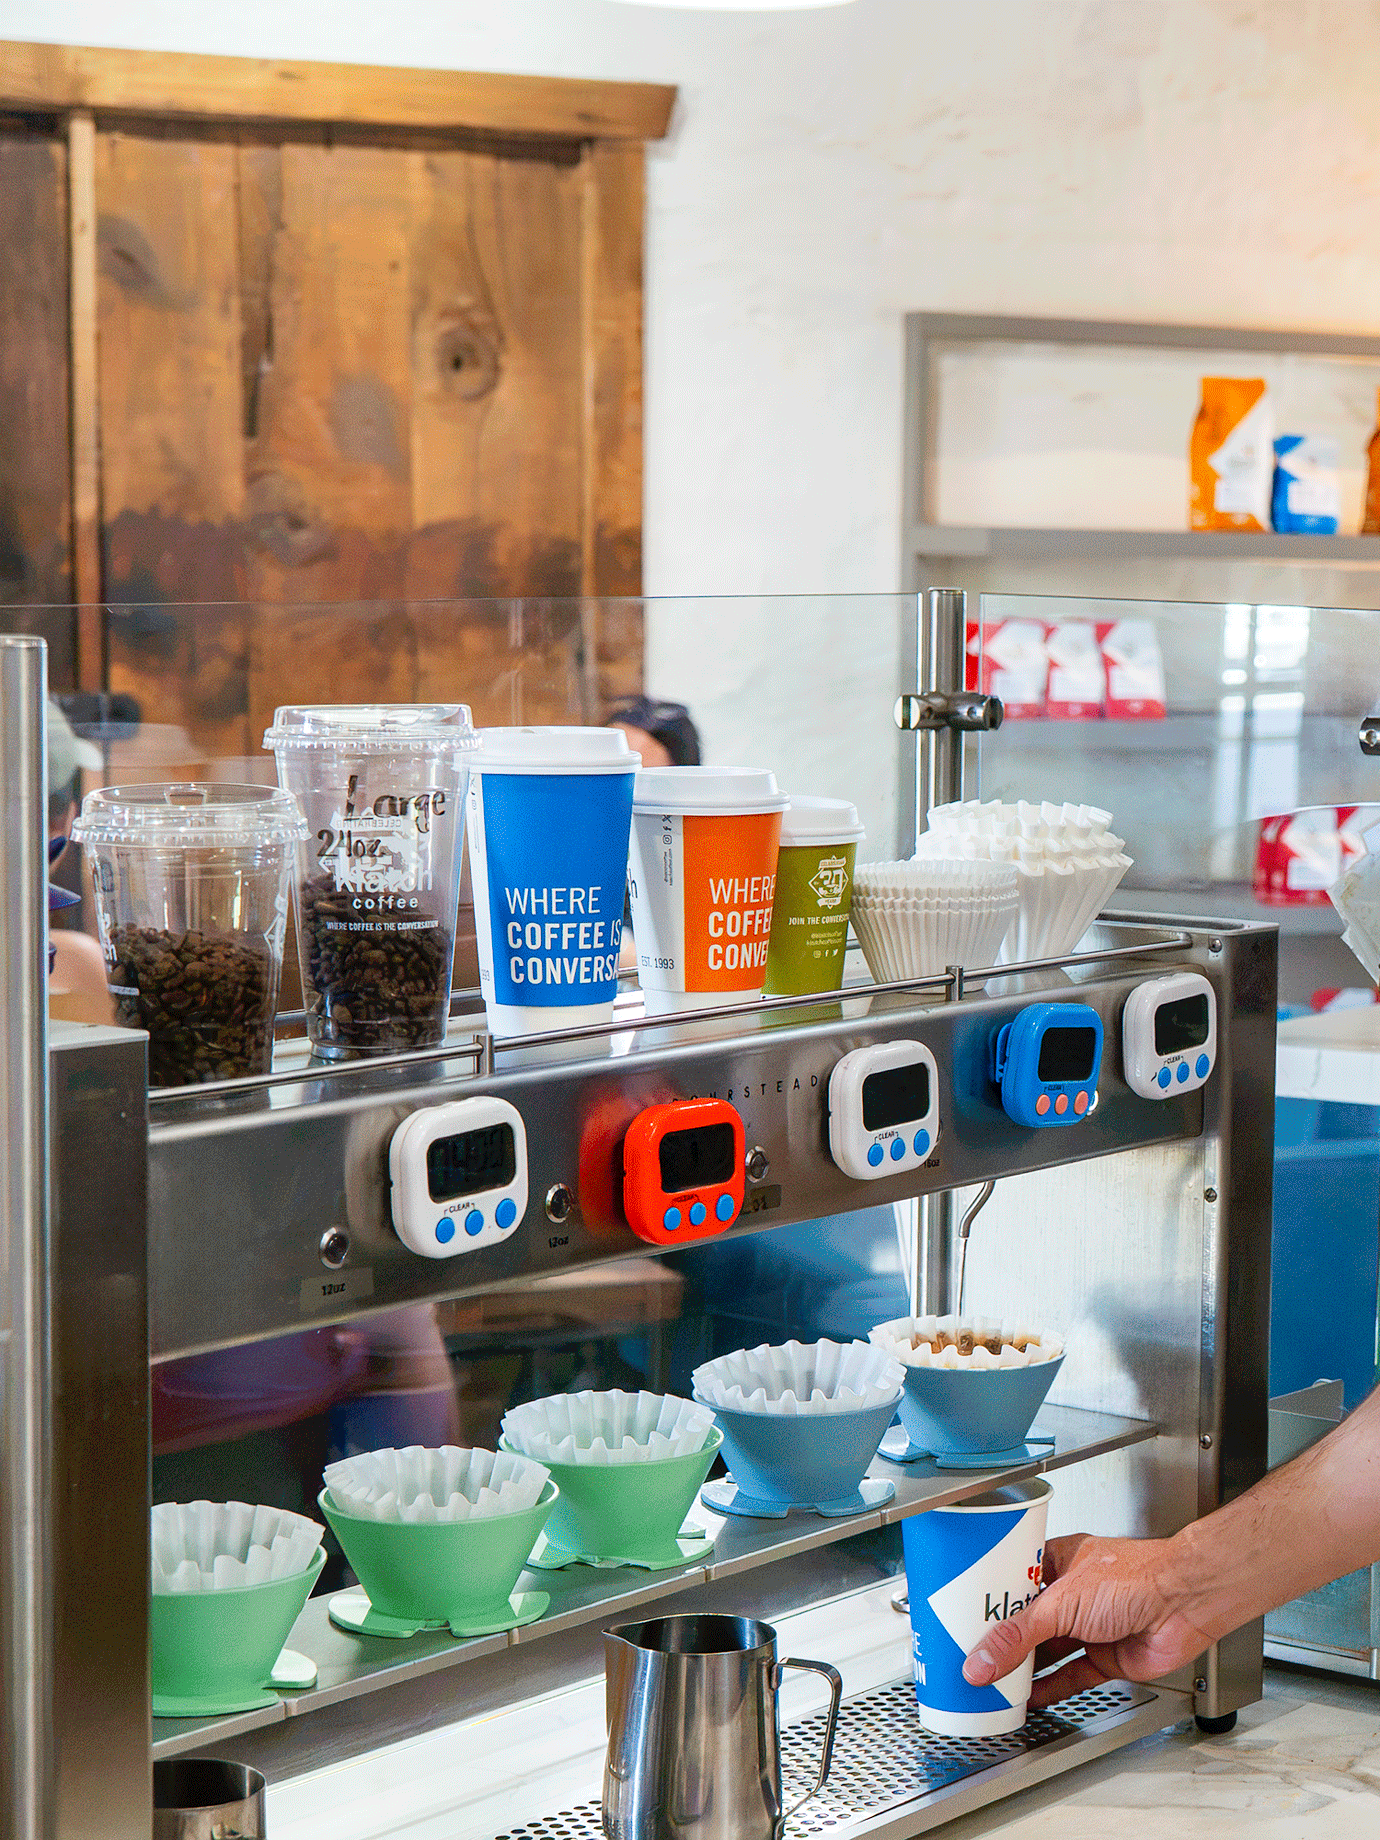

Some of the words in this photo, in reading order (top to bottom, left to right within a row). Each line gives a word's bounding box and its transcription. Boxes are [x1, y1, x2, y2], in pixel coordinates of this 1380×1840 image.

[343, 775, 445, 833] Large
[709, 874, 776, 904] WHERE
[352, 895, 419, 909] coffee
[504, 886, 602, 915] WHERE
[325, 921, 348, 930] WHERE
[348, 921, 374, 931] COFFEE
[375, 922, 382, 931] IS
[383, 922, 396, 931] THE
[788, 916, 805, 926] JOIN
[806, 915, 821, 925] THE
[507, 921, 605, 950] COFFEE
[610, 918, 621, 947] IS
[654, 957, 675, 970] 1993
[878, 1130, 895, 1141] CLEAR
[448, 1201, 470, 1214] CLEAR
